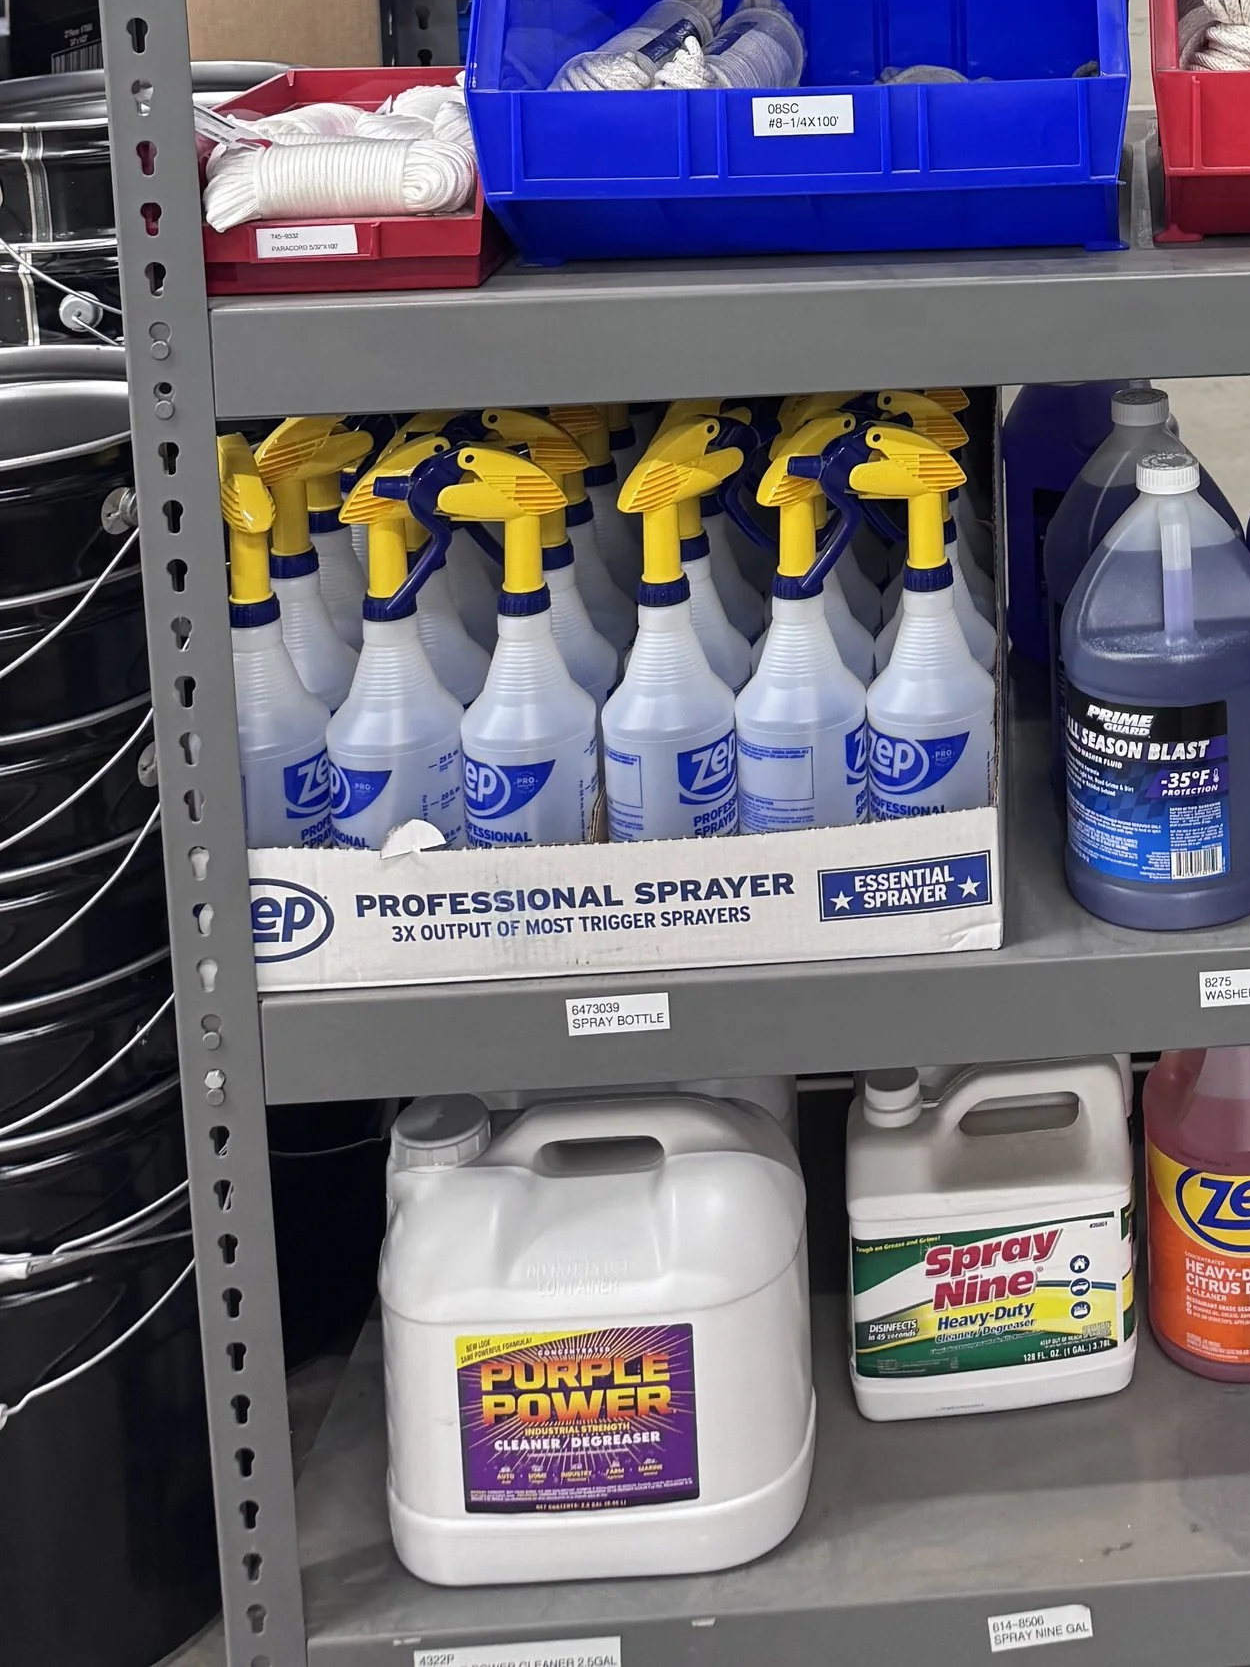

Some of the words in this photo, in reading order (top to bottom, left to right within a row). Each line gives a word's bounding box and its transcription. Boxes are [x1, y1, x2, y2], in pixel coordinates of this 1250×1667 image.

[768, 103, 799, 114] 08SC
[769, 116, 838, 128] #8-1/4X100'
[1082, 728, 1142, 759] SEASON
[1148, 740, 1209, 760] BLAST
[855, 865, 954, 893] ESSENTIAL
[356, 885, 623, 917] PROFESSIONAL
[635, 873, 794, 904] SPRAYER
[863, 885, 947, 908] SPRAYER
[392, 925, 414, 942] 3X
[421, 922, 491, 941] OUTPUT
[498, 921, 518, 936] OF
[527, 917, 574, 935] MOST
[579, 912, 655, 932] TRIGGER
[661, 906, 750, 926] SPRAYERS
[1204, 976, 1231, 987] 8275
[572, 1002, 619, 1015] 6473039
[573, 1017, 613, 1029] SPRAY
[617, 1013, 664, 1025] BOTTLE
[926, 1228, 1063, 1278] Spray
[933, 1270, 1035, 1311] Nine
[1186, 1273, 1240, 1294] CITRUS
[938, 1303, 1035, 1331] Heavy-Duty
[480, 1353, 670, 1391] PURPLE
[481, 1386, 672, 1426] POWER
[994, 1630, 1032, 1645] SPRAY
[1035, 1625, 1063, 1638] NINE
[1066, 1622, 1089, 1633] GAL
[420, 1654, 454, 1666] 4322P
